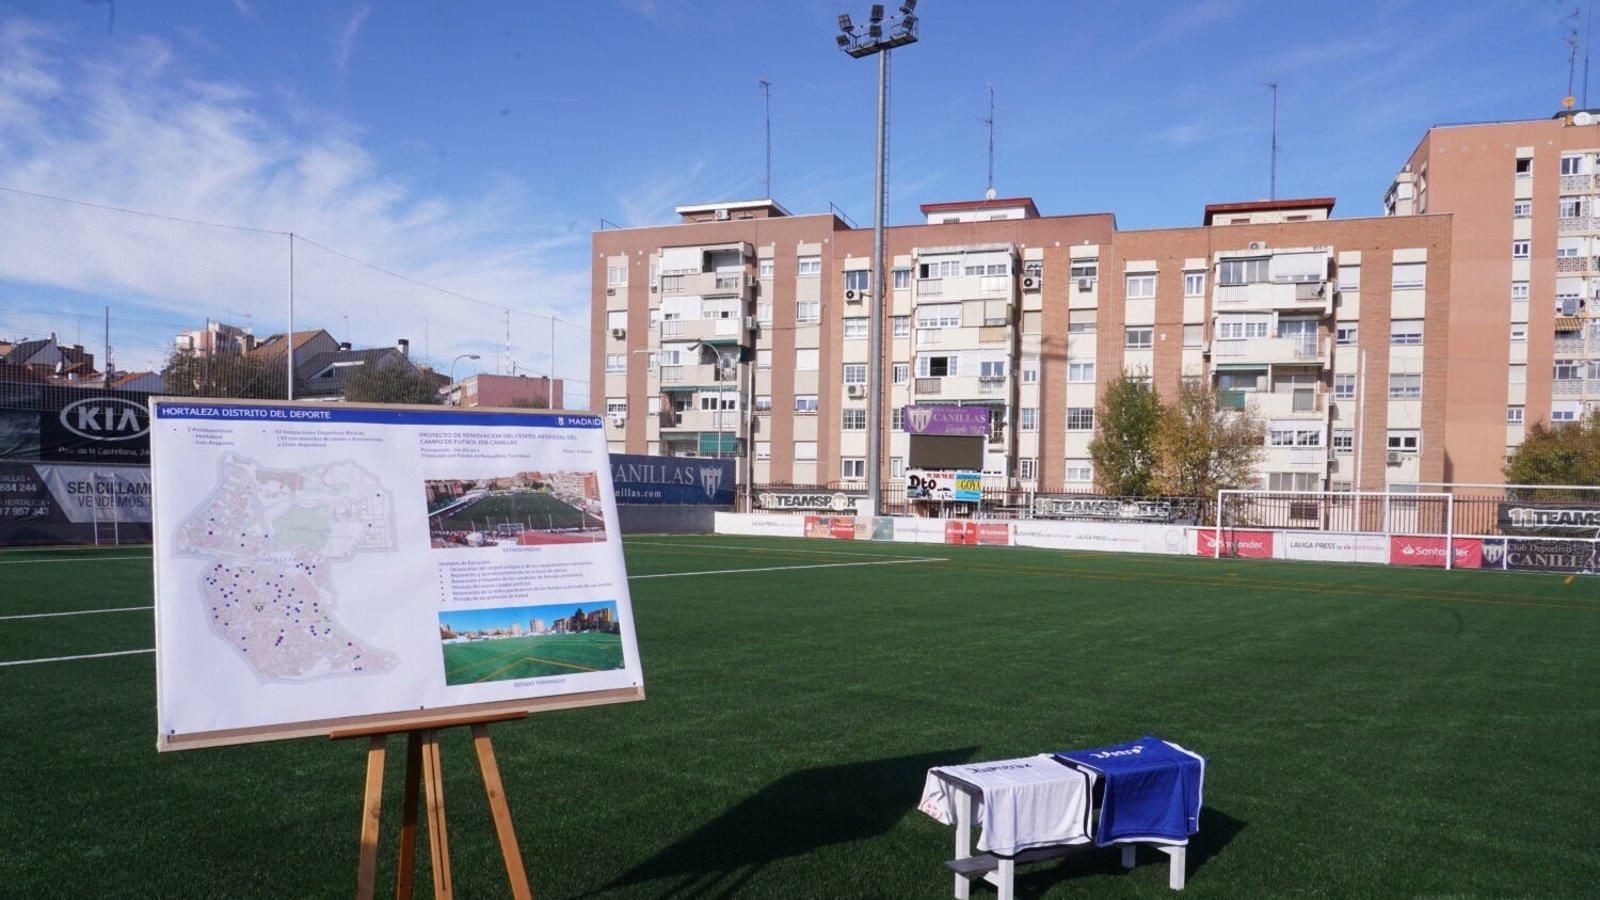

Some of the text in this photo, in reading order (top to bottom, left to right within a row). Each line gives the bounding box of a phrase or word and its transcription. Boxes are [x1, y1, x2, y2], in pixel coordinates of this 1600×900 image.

[78, 406, 140, 431] KIA
[162, 407, 331, 419] HORTALEZA DISTRITO DEL DEPORTE
[932, 412, 986, 424] CANILLAS
[568, 417, 602, 427] MADRID
[909, 475, 937, 490] Dto
[1290, 541, 1314, 549] LALIGA
[1314, 542, 1335, 550] PRESS
[1507, 543, 1528, 552] Club
[1507, 553, 1600, 569] CANILLA
